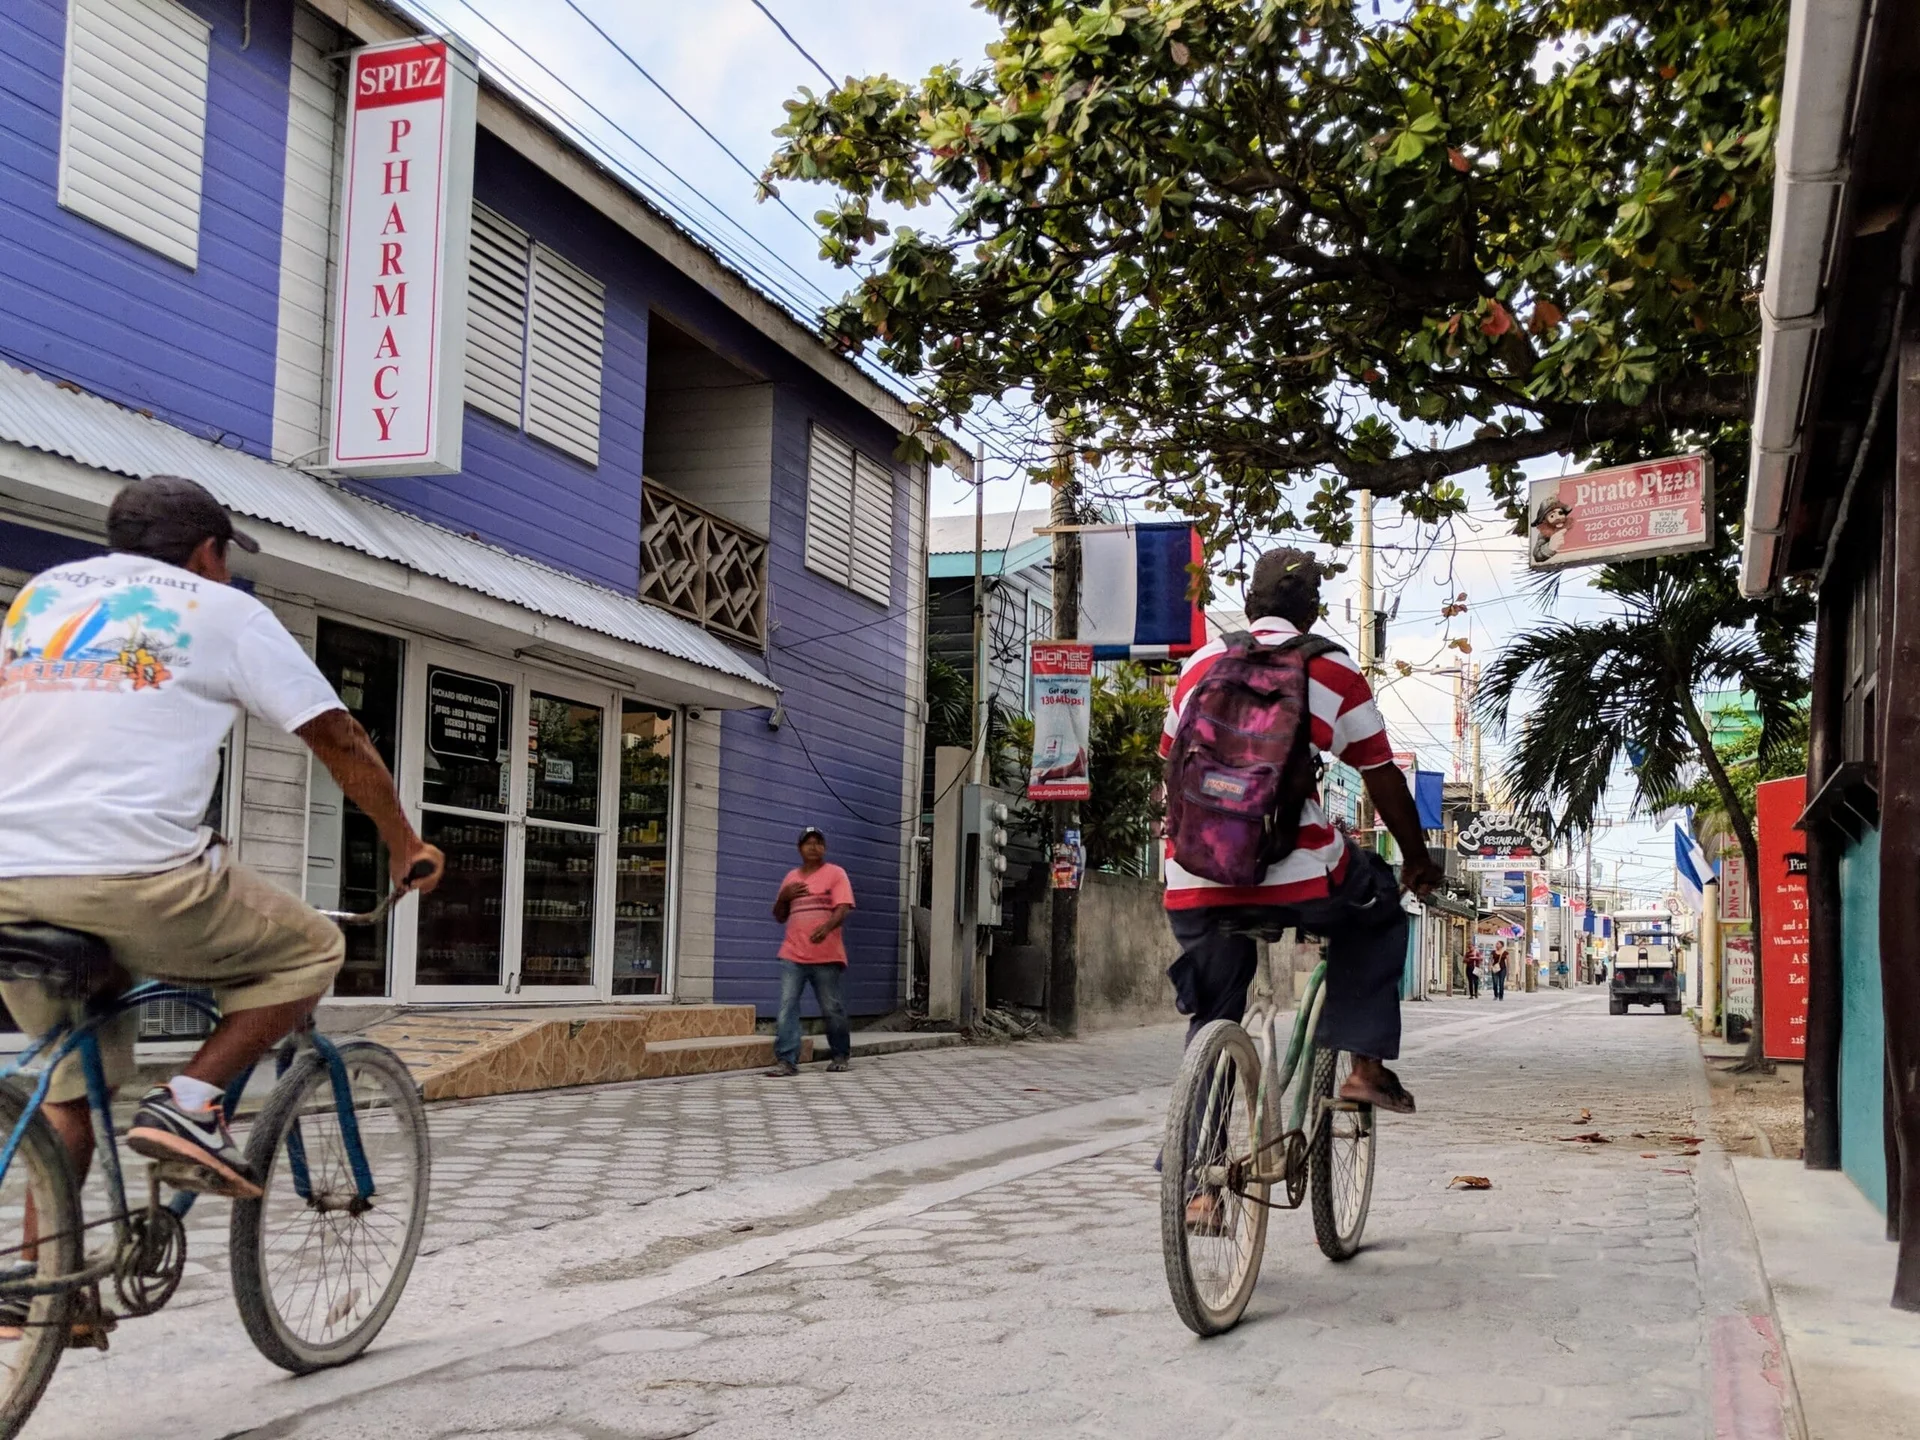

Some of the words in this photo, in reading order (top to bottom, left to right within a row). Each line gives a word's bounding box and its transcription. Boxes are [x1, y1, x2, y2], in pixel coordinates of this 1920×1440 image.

[359, 58, 442, 96] SPIEZ
[370, 119, 412, 441] PHARMACY
[1575, 476, 1637, 507] Pirate
[1639, 469, 1696, 497] Pizza
[1581, 501, 1630, 517] AMBERGRIS
[1630, 497, 1654, 508] CAYE
[1658, 492, 1690, 504] BELIZE
[1584, 513, 1644, 532] 226-GOOD
[1587, 525, 1643, 543] (226-4663)
[1070, 687, 1078, 695] to
[1041, 696, 1055, 705] 130
[1483, 836, 1526, 846] RESTAURANT
[1497, 846, 1512, 855] BAR
[1789, 858, 1807, 871] Pira
[1792, 899, 1803, 910] Yo
[1782, 919, 1796, 931] and
[1727, 957, 1753, 966] EATIN
[1791, 952, 1800, 964] A
[1788, 973, 1805, 984] Eat
